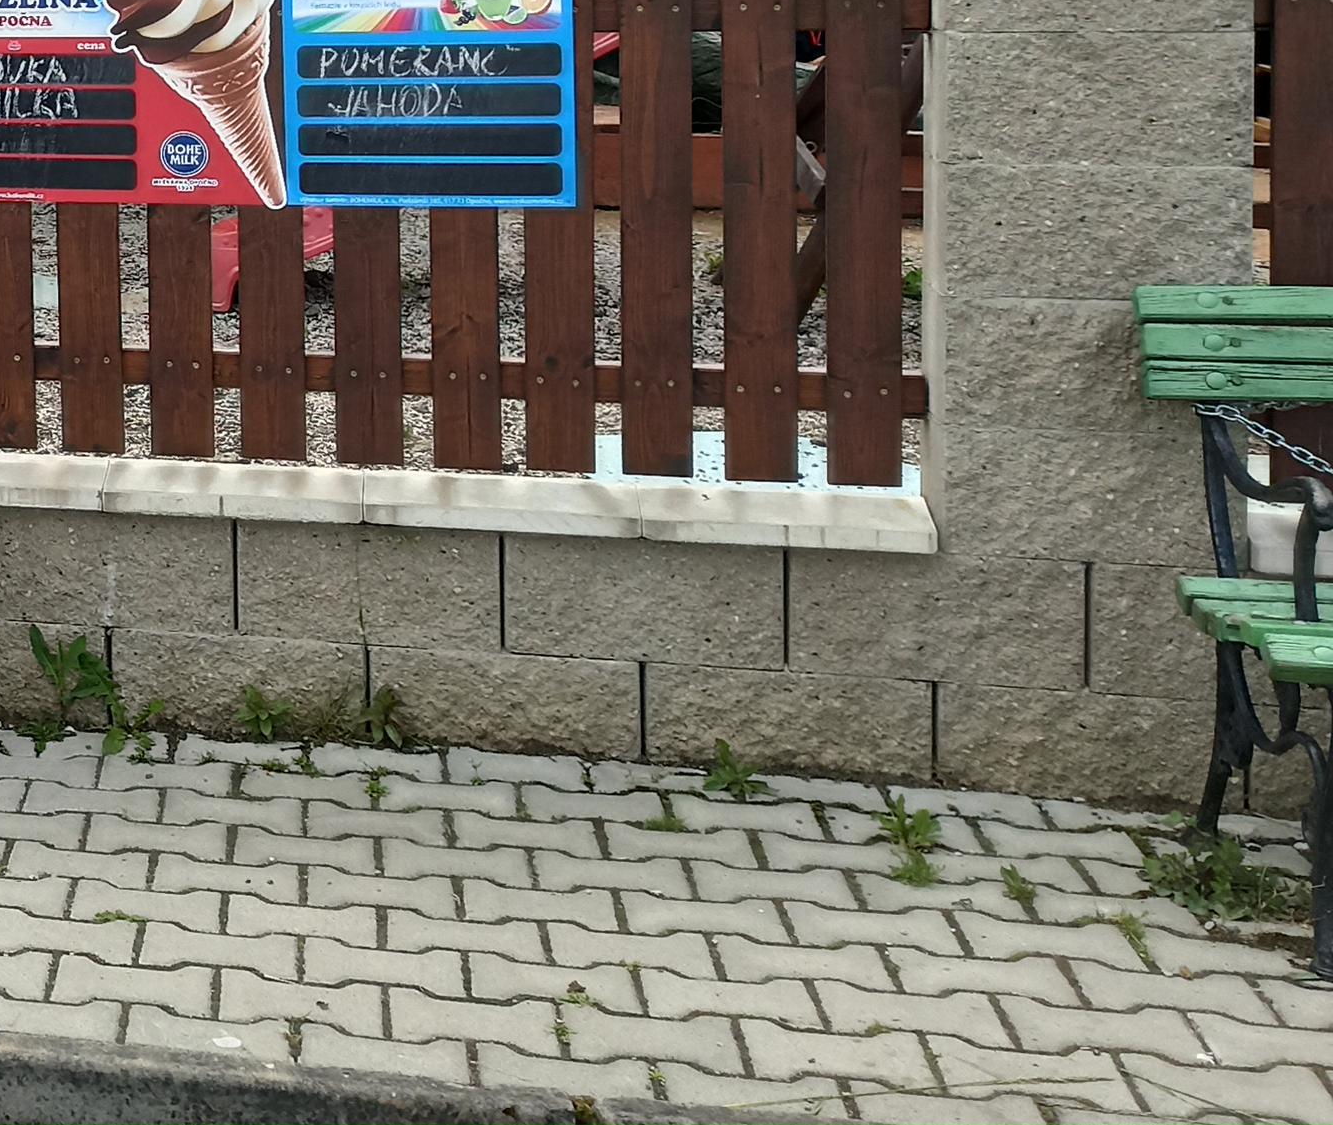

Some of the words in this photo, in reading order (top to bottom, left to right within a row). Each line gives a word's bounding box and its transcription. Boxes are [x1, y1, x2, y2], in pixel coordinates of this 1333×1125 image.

[77, 42, 106, 51] cena
[328, 83, 464, 117] JAHODA
[170, 155, 199, 165] MILK
